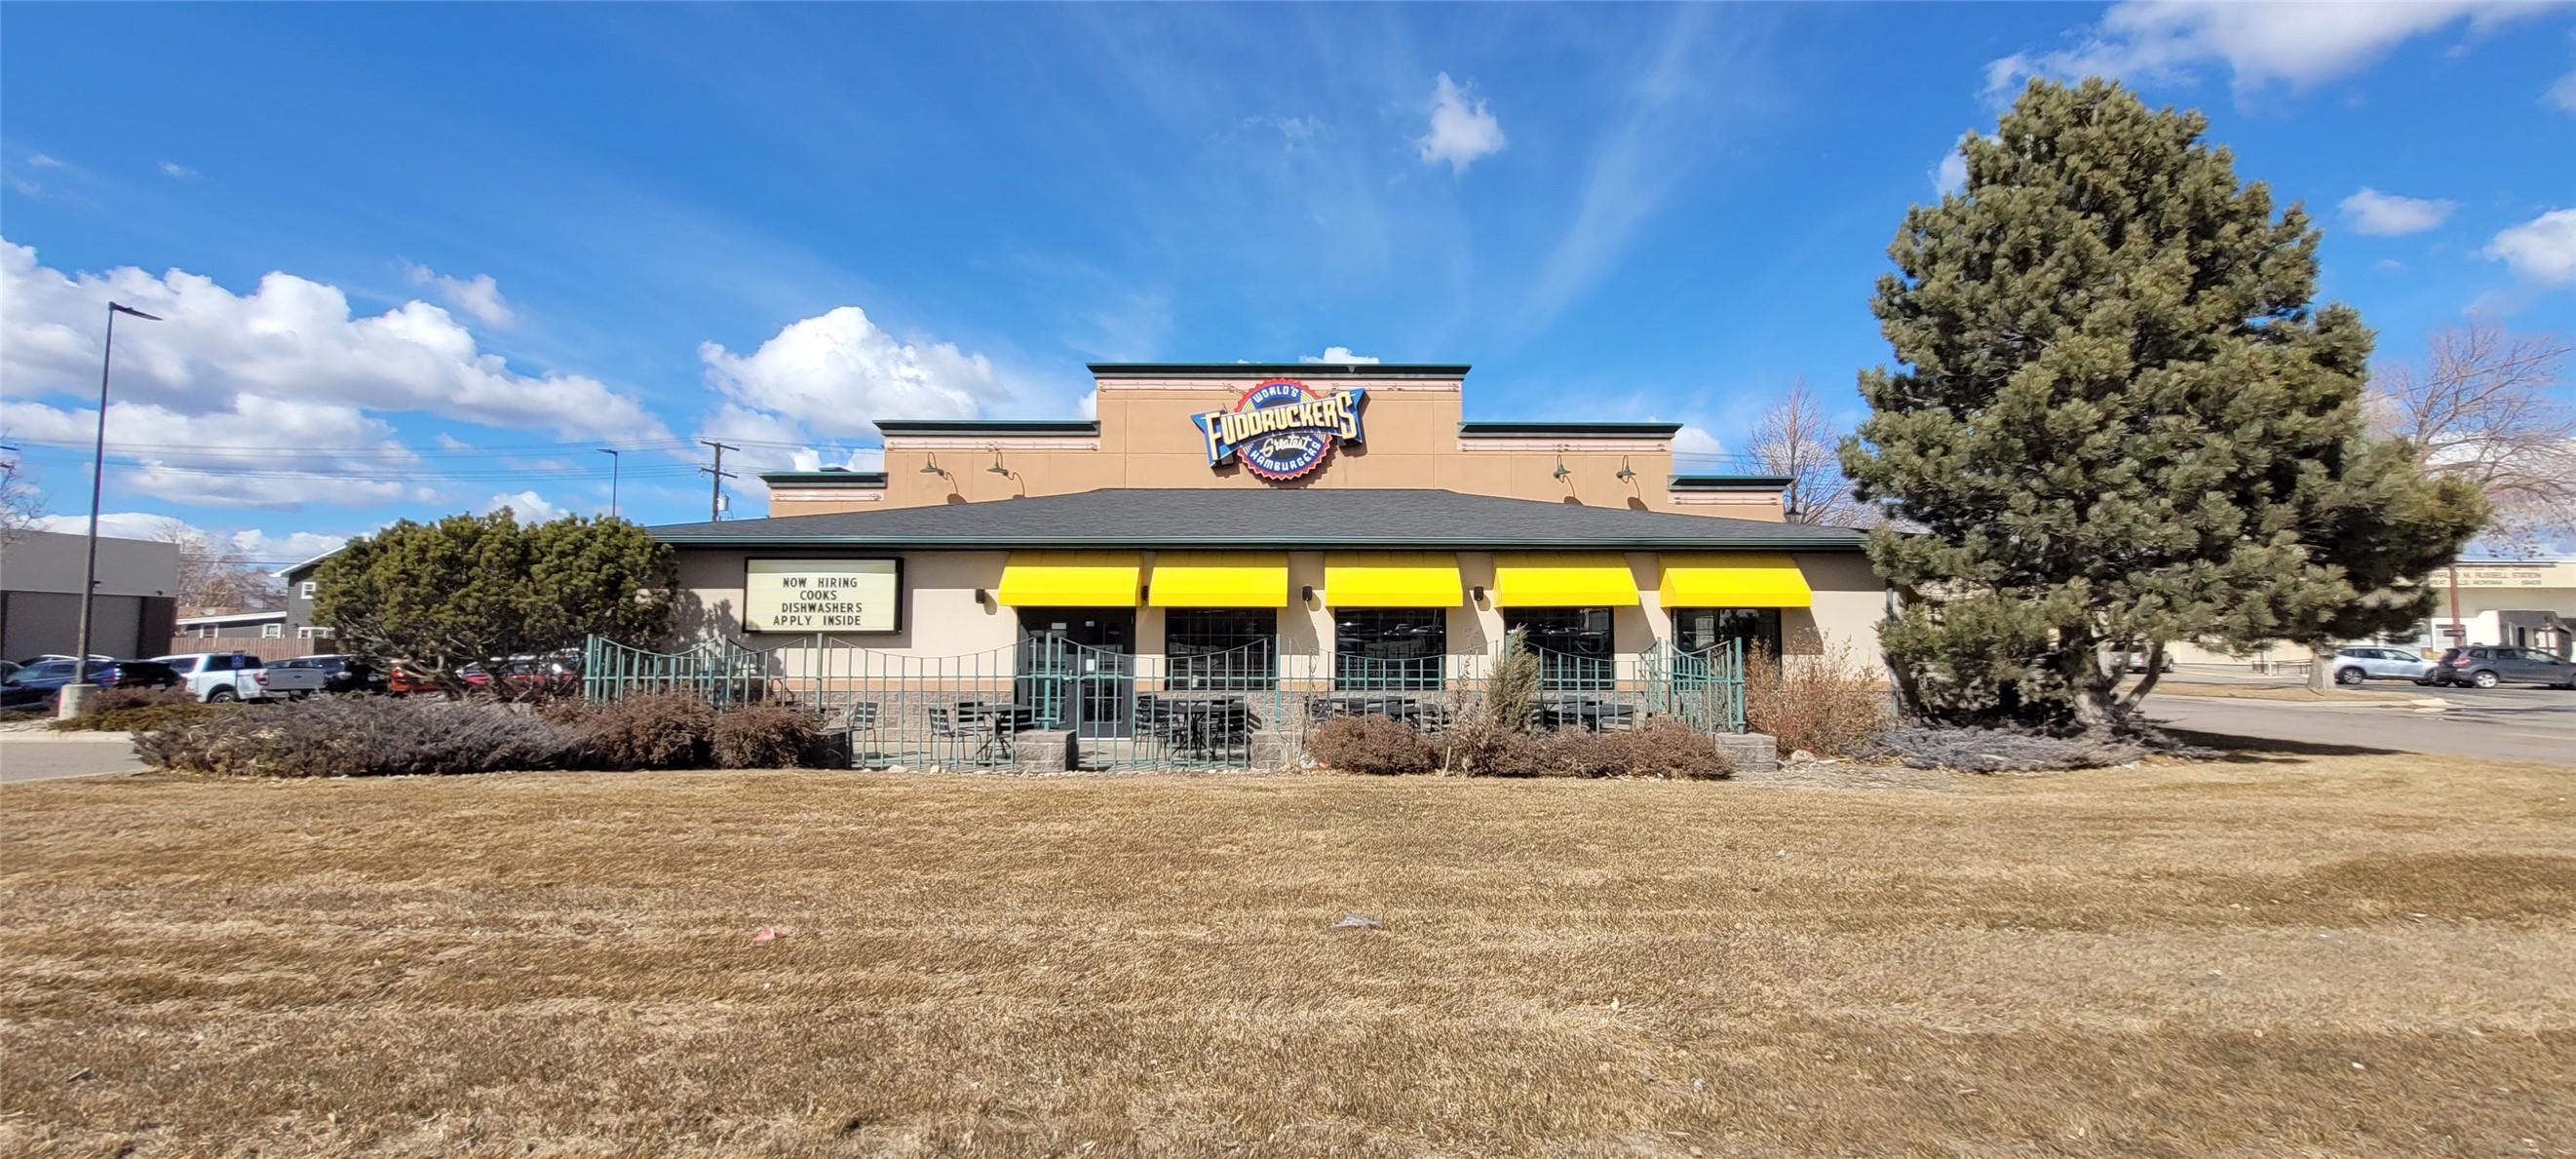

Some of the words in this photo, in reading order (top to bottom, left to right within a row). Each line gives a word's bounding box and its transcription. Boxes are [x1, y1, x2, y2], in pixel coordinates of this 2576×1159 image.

[1252, 385, 1299, 403] WORLD'S
[1205, 391, 1357, 461] FUDDRUCKERS
[1259, 436, 1312, 457] Greatest
[1250, 441, 1322, 472] HAMBURGERS
[783, 577, 807, 588] NOW
[818, 577, 858, 588] HIRING
[799, 590, 837, 600] COOKS
[782, 602, 863, 613] DISHWASHERS
[773, 615, 812, 626] APPLY
[823, 615, 861, 626] INSIDE
